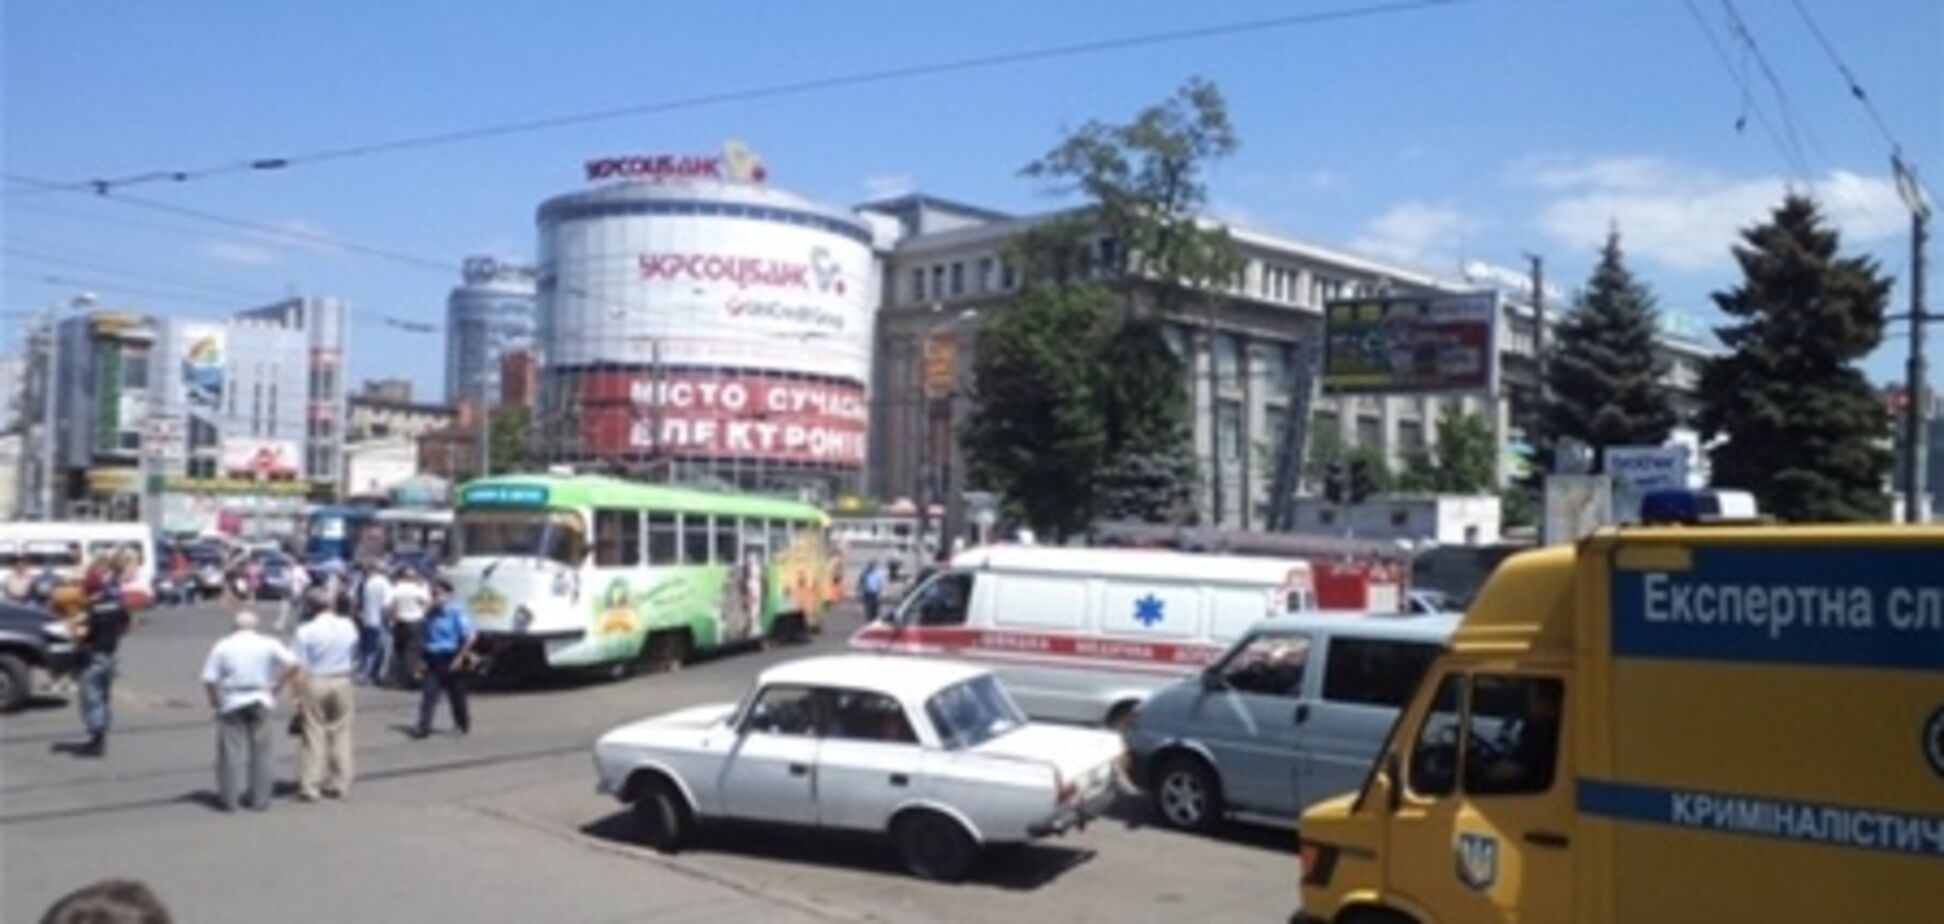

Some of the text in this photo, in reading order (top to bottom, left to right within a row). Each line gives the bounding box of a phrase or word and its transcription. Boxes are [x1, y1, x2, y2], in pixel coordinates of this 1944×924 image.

[630, 380, 748, 409] МІСТО
[1644, 573, 1874, 639] Експертна
[1671, 792, 1944, 853] КРИМІНАЛІСТИЧ
